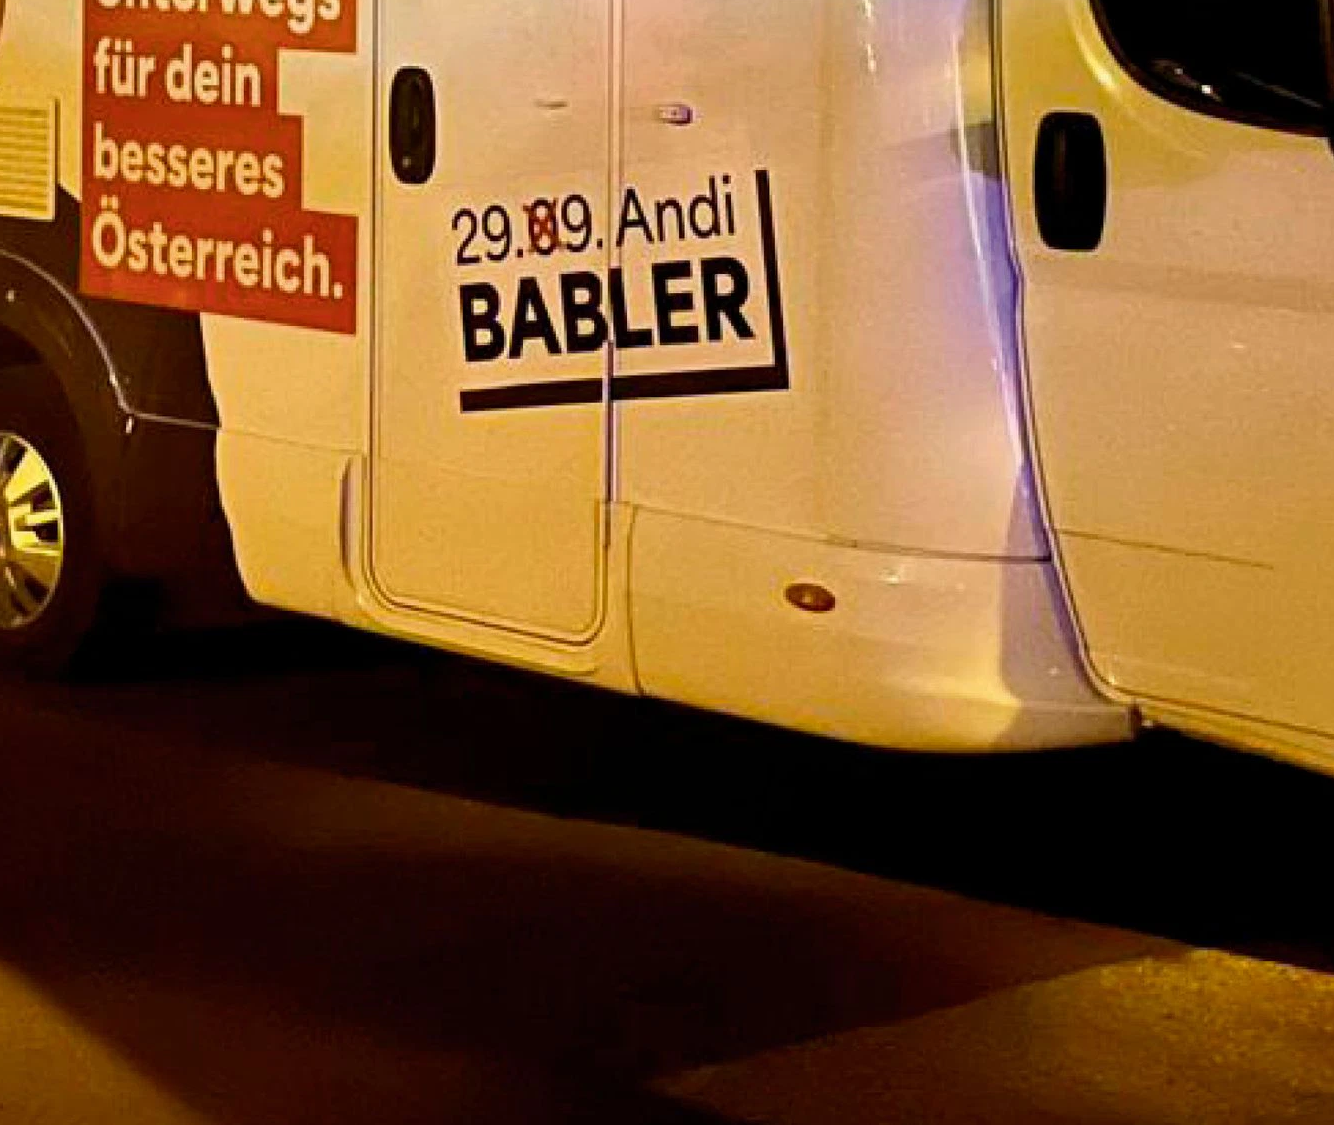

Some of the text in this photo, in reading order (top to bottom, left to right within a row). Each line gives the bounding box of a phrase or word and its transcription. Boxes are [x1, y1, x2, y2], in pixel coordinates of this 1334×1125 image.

[94, 36, 261, 107] für dein
[94, 122, 285, 198] besseres
[92, 195, 344, 300] Österreich.
[616, 175, 736, 248] Andi
[459, 257, 755, 362] BABLER
